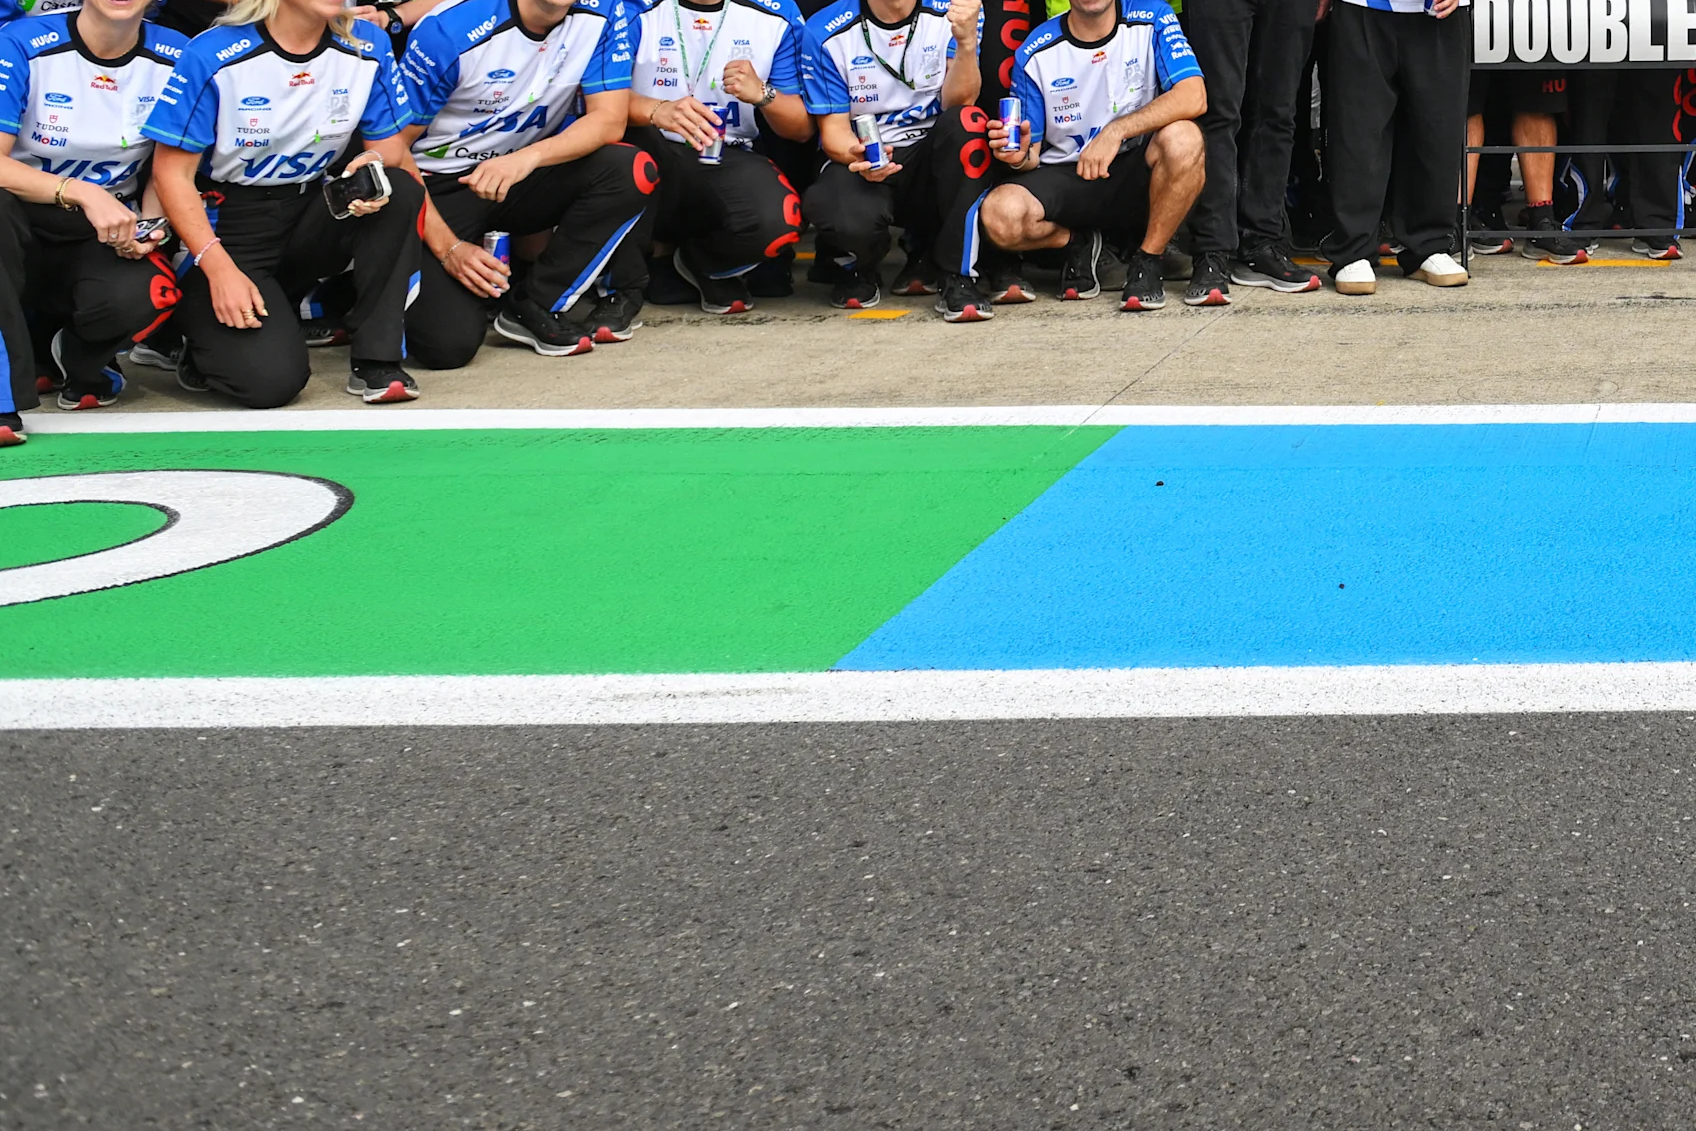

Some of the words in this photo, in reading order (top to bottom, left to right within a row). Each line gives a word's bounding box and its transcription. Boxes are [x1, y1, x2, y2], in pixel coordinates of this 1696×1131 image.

[825, 11, 853, 32] HUGO
[1127, 10, 1154, 19] HUGO
[467, 15, 497, 43] HUGO
[30, 31, 59, 48] HUGO
[1024, 32, 1053, 55] HUGO
[155, 43, 183, 58] HUG
[215, 39, 251, 62] HUGO
[653, 79, 678, 87] obil
[478, 97, 510, 105] TUDOR
[849, 95, 879, 104] Mobil
[1053, 102, 1080, 112] TUDOR
[1054, 112, 1082, 124] Mobil
[36, 122, 69, 133] TUDOR
[31, 131, 67, 147] Mobil
[234, 138, 270, 148] Mobil
[455, 147, 499, 161] Cash
[238, 150, 337, 179] VISA
